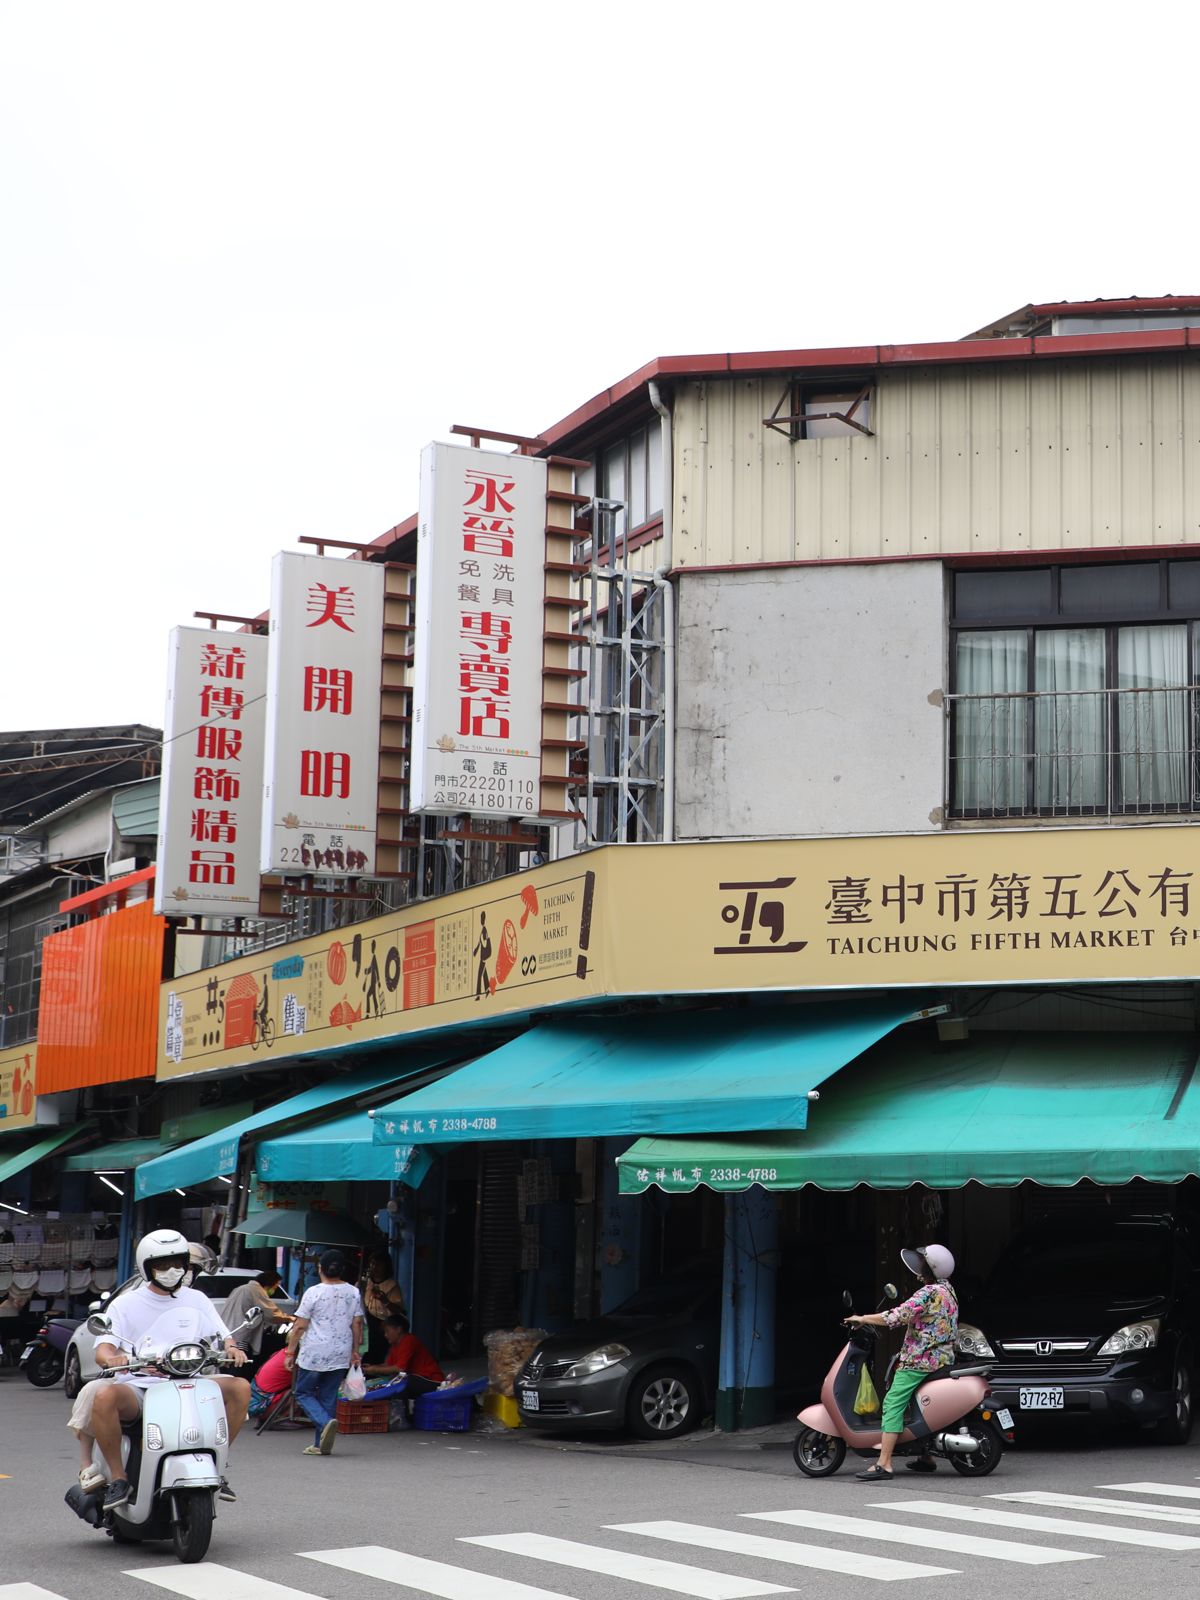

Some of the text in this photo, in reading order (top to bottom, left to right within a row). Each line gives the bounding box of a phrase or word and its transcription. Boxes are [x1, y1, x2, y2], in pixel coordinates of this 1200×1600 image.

[462, 469, 516, 558] 永晉
[459, 559, 515, 582] 免洗
[457, 583, 514, 607] 餐具
[456, 610, 513, 739] 專賣店
[299, 581, 356, 800] 美開明
[188, 642, 247, 885] 薪傳服飾精品
[462, 758, 508, 776] 電話
[434, 774, 534, 794] 門市22220110
[433, 791, 533, 811] 公司24180176
[543, 890, 576, 909] TAICHUNG
[543, 911, 561, 925] FIFTH
[543, 925, 569, 941] MARKET
[826, 929, 1155, 955] TAICHUNG FIFTH MARKET
[442, 1117, 497, 1131] 2338-4788
[710, 1168, 778, 1181] 2338-4788
[1020, 1391, 1064, 1406] 3772-RZ
